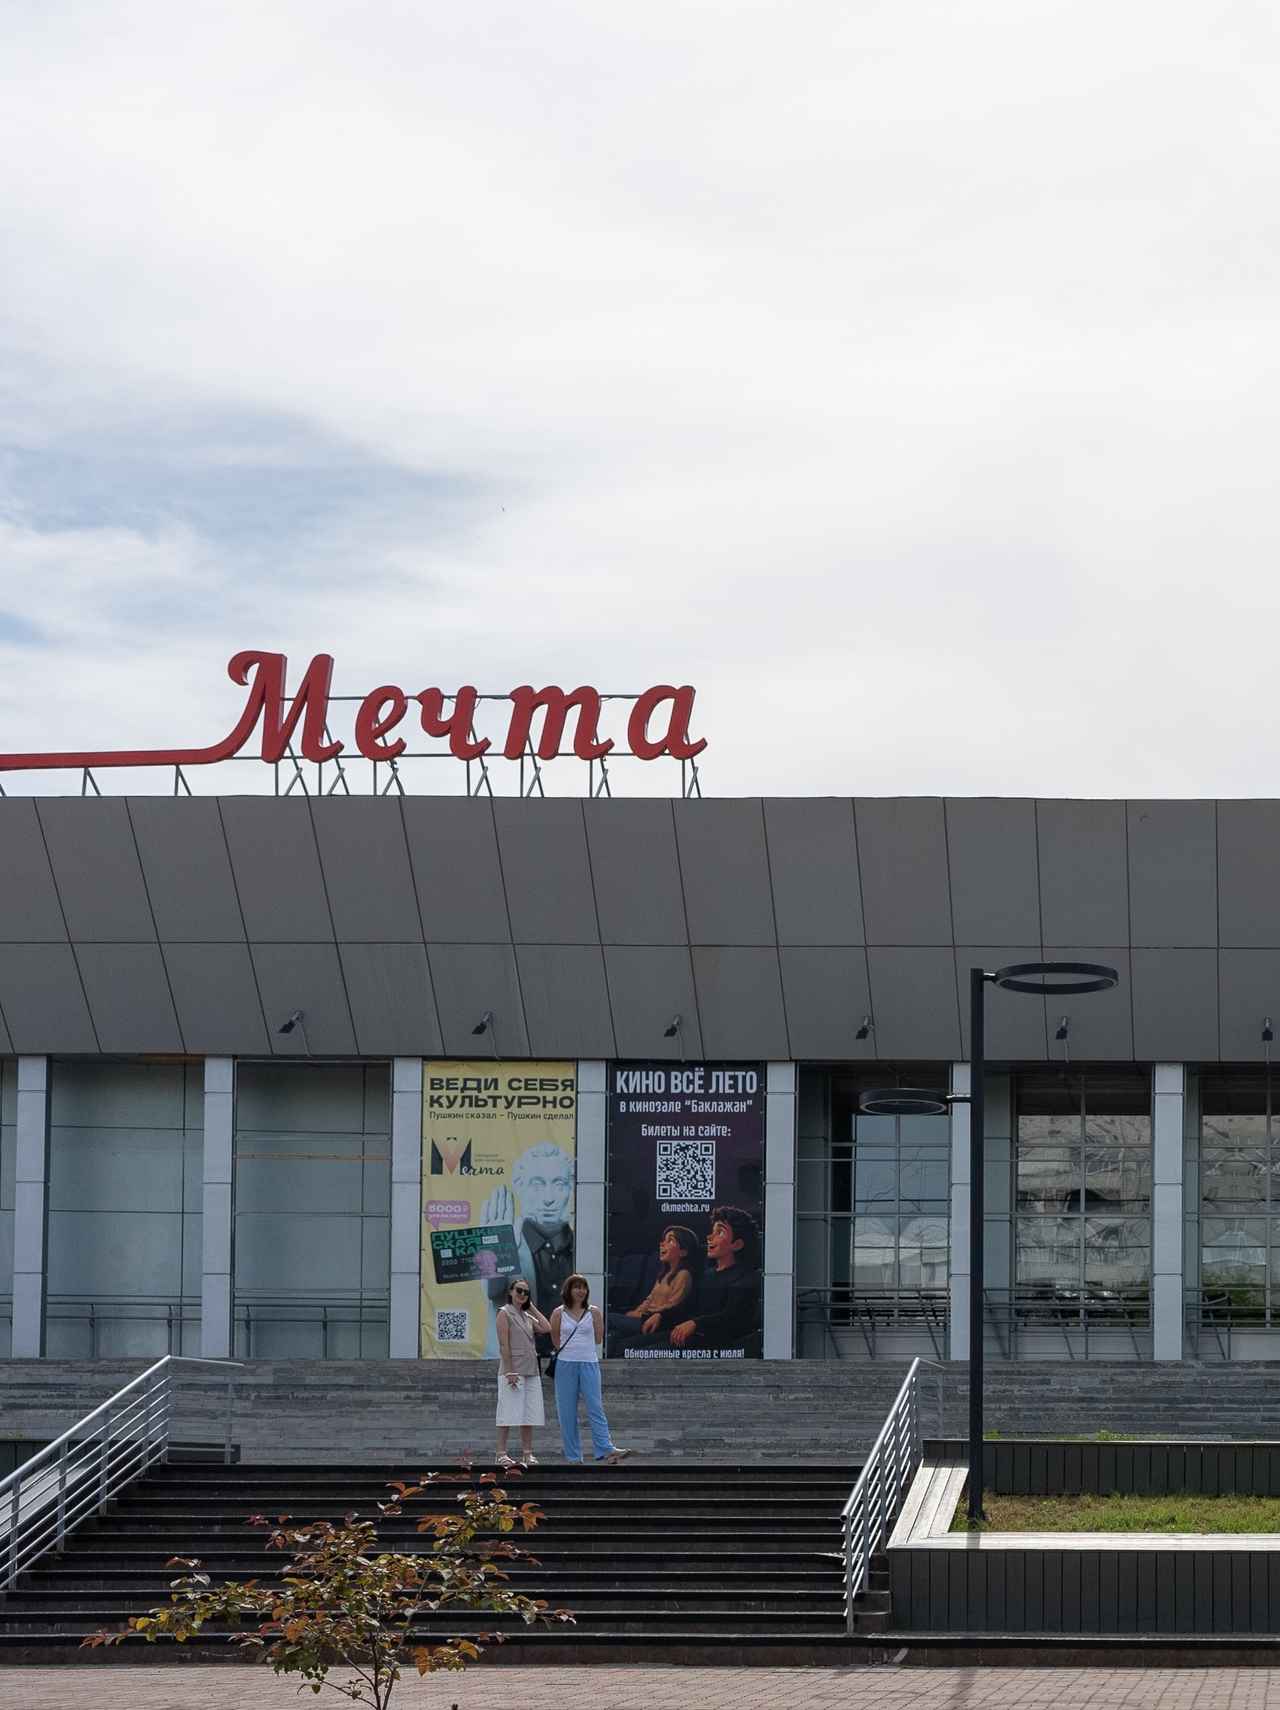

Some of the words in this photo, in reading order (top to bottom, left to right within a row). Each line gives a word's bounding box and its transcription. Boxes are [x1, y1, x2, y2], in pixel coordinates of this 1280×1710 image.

[226, 650, 708, 765] Мечта
[429, 1077, 499, 1093] ВЕДИ
[507, 1077, 575, 1092] СЕБЯ
[616, 1071, 666, 1094] КИНО
[670, 1067, 705, 1094] ВСЁ
[708, 1071, 757, 1094] ЛЕТО
[429, 1094, 575, 1110] КУЛЬТУРНО
[620, 1101, 626, 1112] в
[629, 1101, 681, 1113] кинозале
[429, 1111, 464, 1121] Пушкин
[465, 1112, 497, 1120] сказал
[507, 1111, 541, 1121] Пушкин
[543, 1112, 574, 1120] сделал
[641, 1123, 680, 1136] Билеты
[683, 1126, 695, 1136] на
[698, 1124, 732, 1137] сайте:
[661, 1203, 710, 1213] dkmechta.ru
[624, 1348, 680, 1359] Обновленные
[682, 1350, 711, 1359] кресла
[713, 1350, 718, 1358] с
